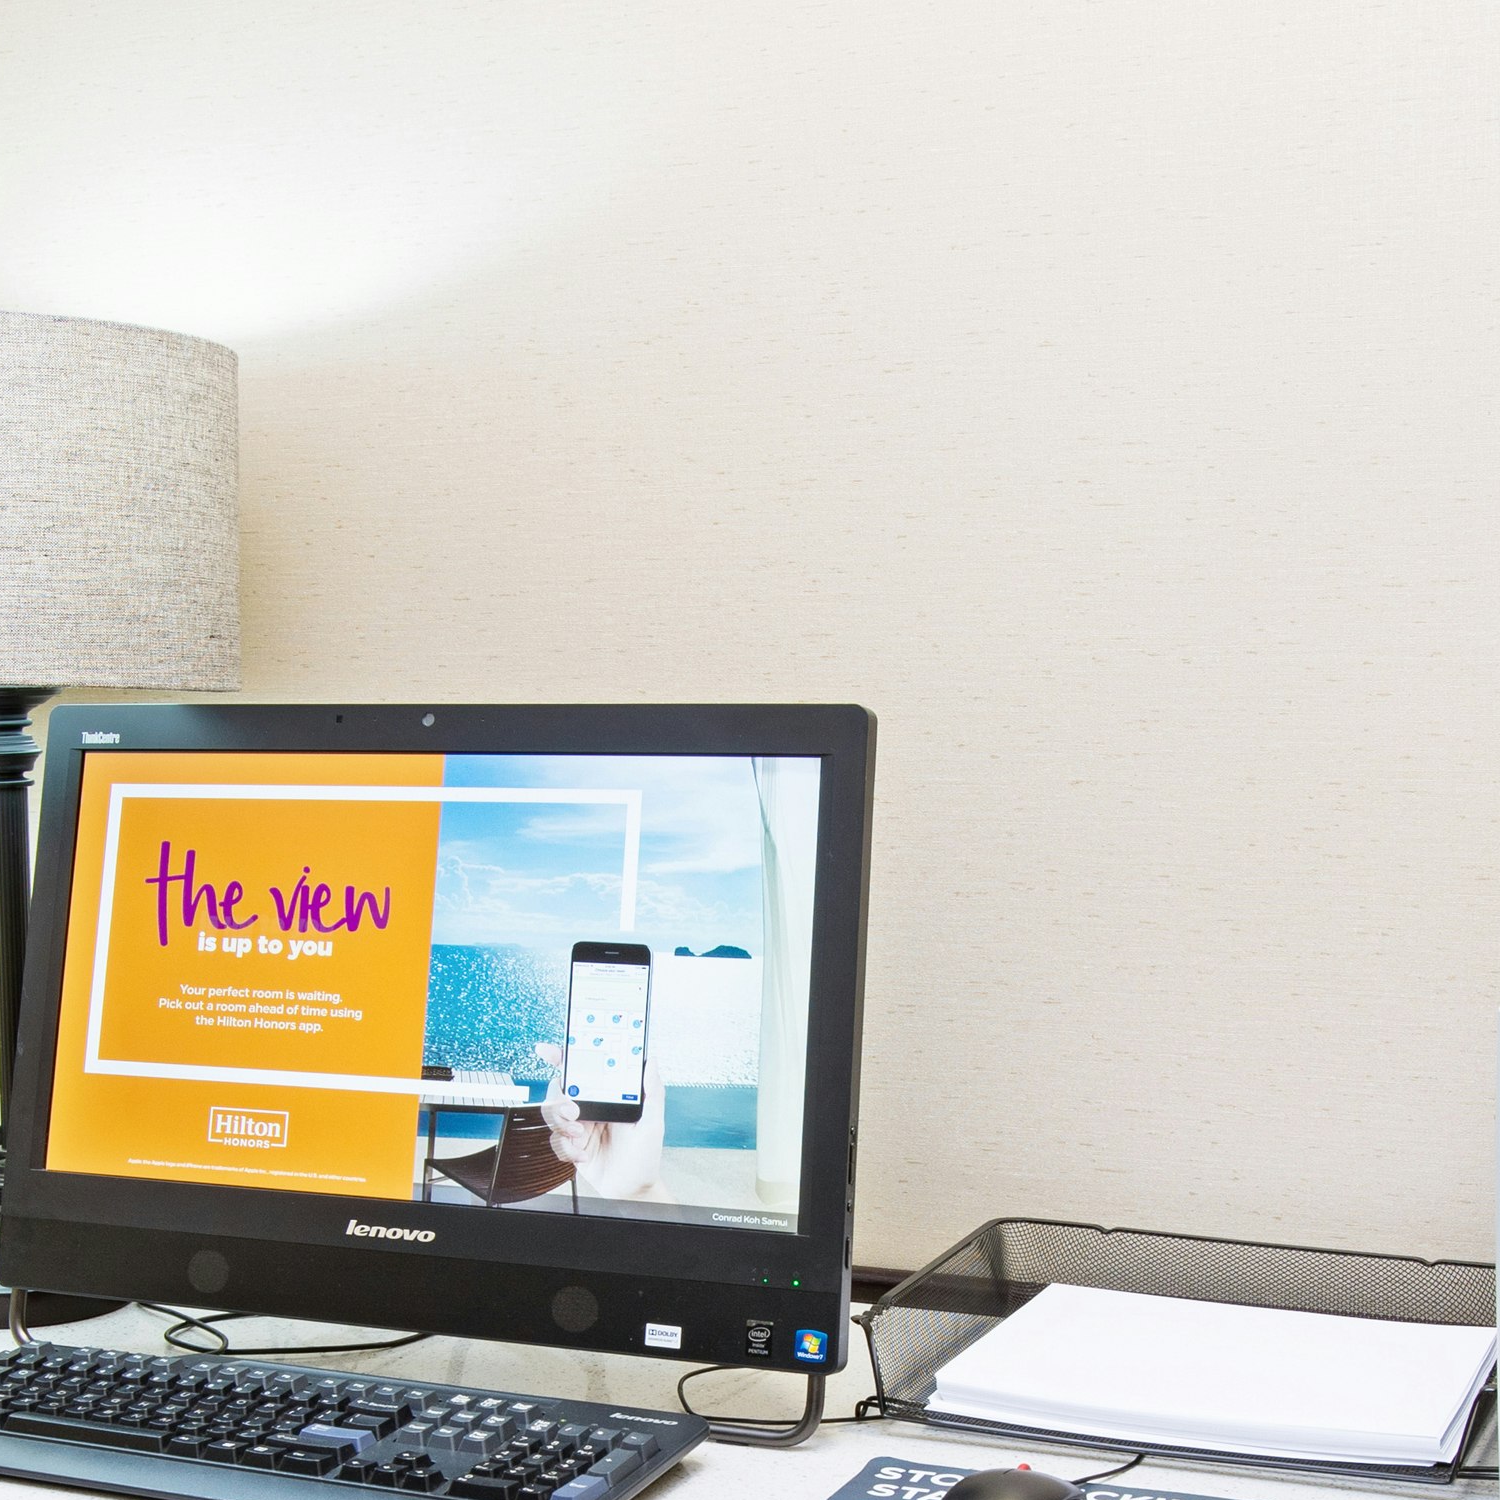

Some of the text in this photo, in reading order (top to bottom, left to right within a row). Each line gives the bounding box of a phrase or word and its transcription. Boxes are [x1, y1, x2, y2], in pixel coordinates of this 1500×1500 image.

[145, 841, 390, 947] the view
[197, 931, 333, 960] is up to you
[180, 984, 343, 1004] Your perfect room is waiting.
[158, 998, 363, 1021] Pick out a room ahead of time using
[195, 1015, 324, 1034] the Hilton Honors app.
[215, 1113, 281, 1138] Hilton
[223, 1137, 270, 1149] HONORS
[712, 1212, 788, 1227] Conrad Koh Samui
[346, 1219, 436, 1242] lenovo
[657, 1330, 678, 1338] DOLBY
[751, 1330, 767, 1339] intel
[609, 1412, 678, 1426] lenovo
[874, 1467, 965, 1487] STO
